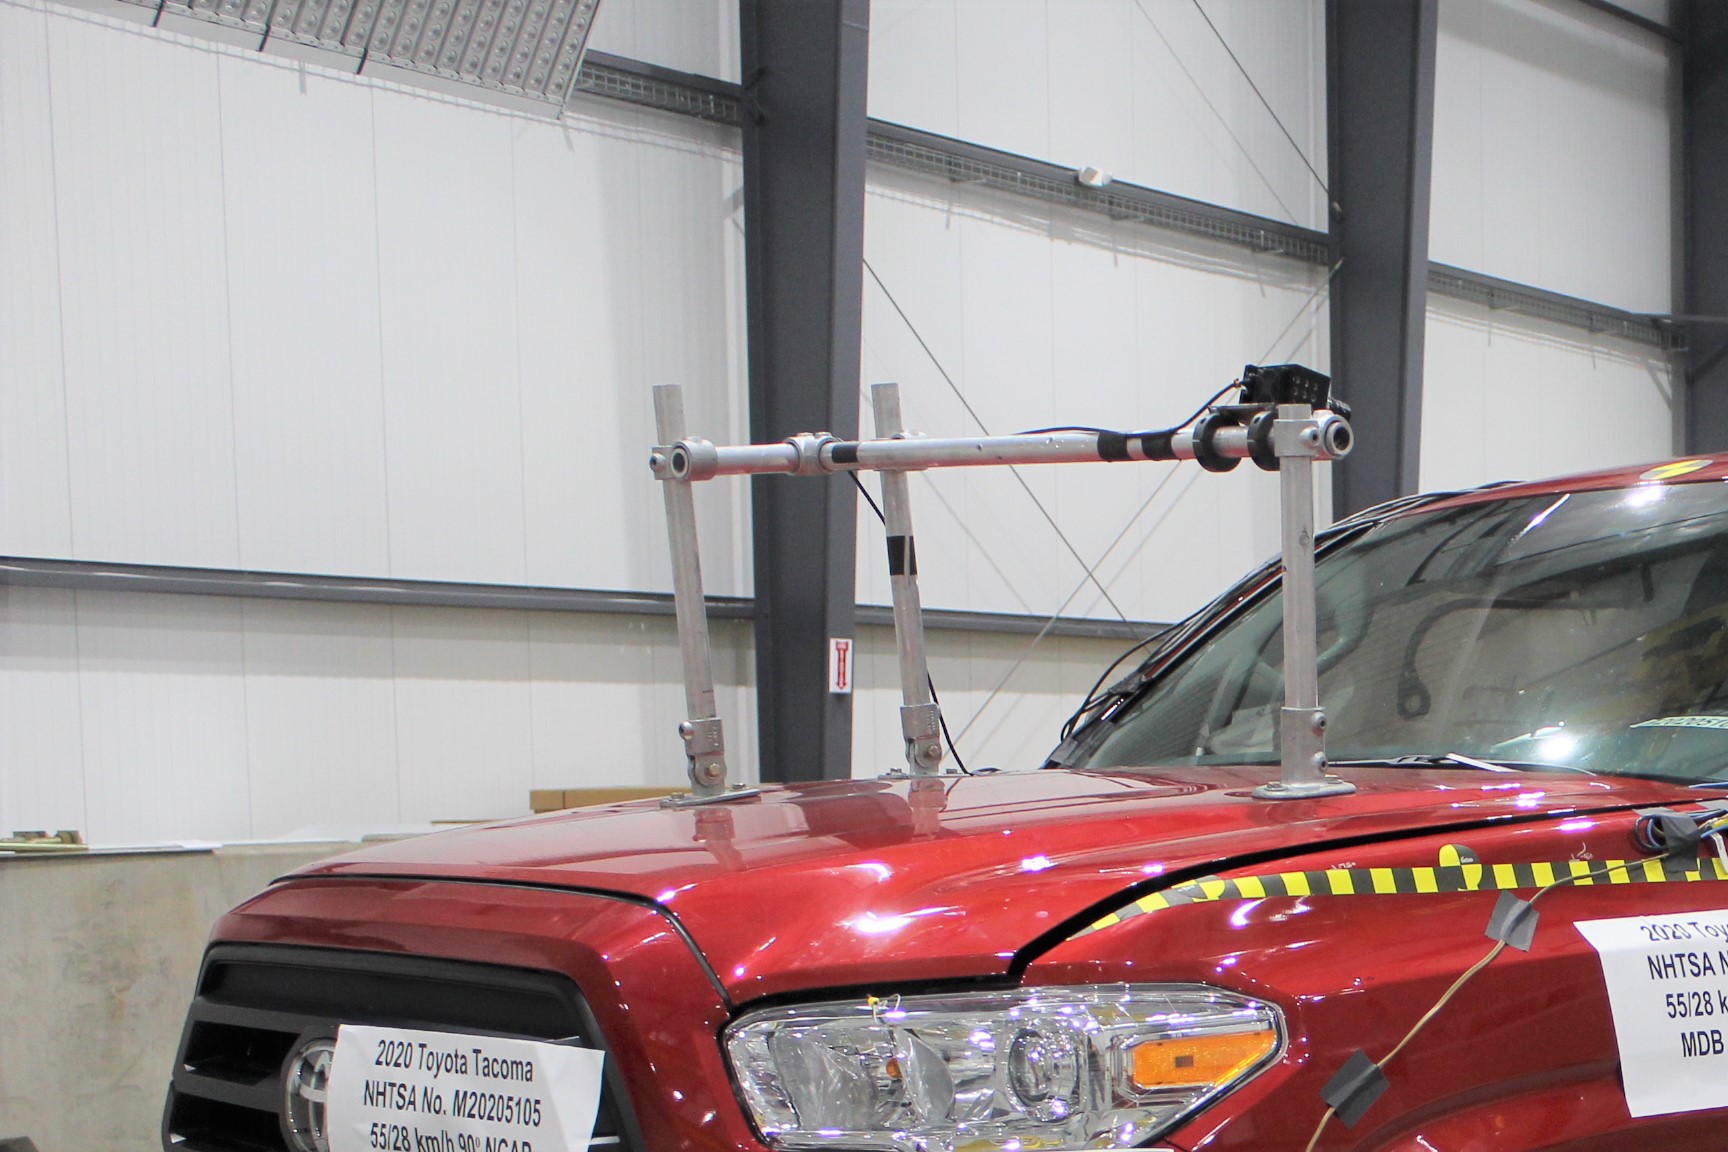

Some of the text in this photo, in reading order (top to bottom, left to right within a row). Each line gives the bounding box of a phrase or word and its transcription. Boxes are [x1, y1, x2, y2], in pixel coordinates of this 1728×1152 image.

[1640, 922, 1692, 942] 2020
[1647, 952, 1716, 980] NHTSA
[1666, 991, 1714, 1019] 55/28
[1681, 1028, 1724, 1058] MDB
[375, 1040, 533, 1082] 2020 Toyota Tacoma
[363, 1079, 542, 1127] NHTSA No. M20205105
[371, 1122, 411, 1152] 55/28
